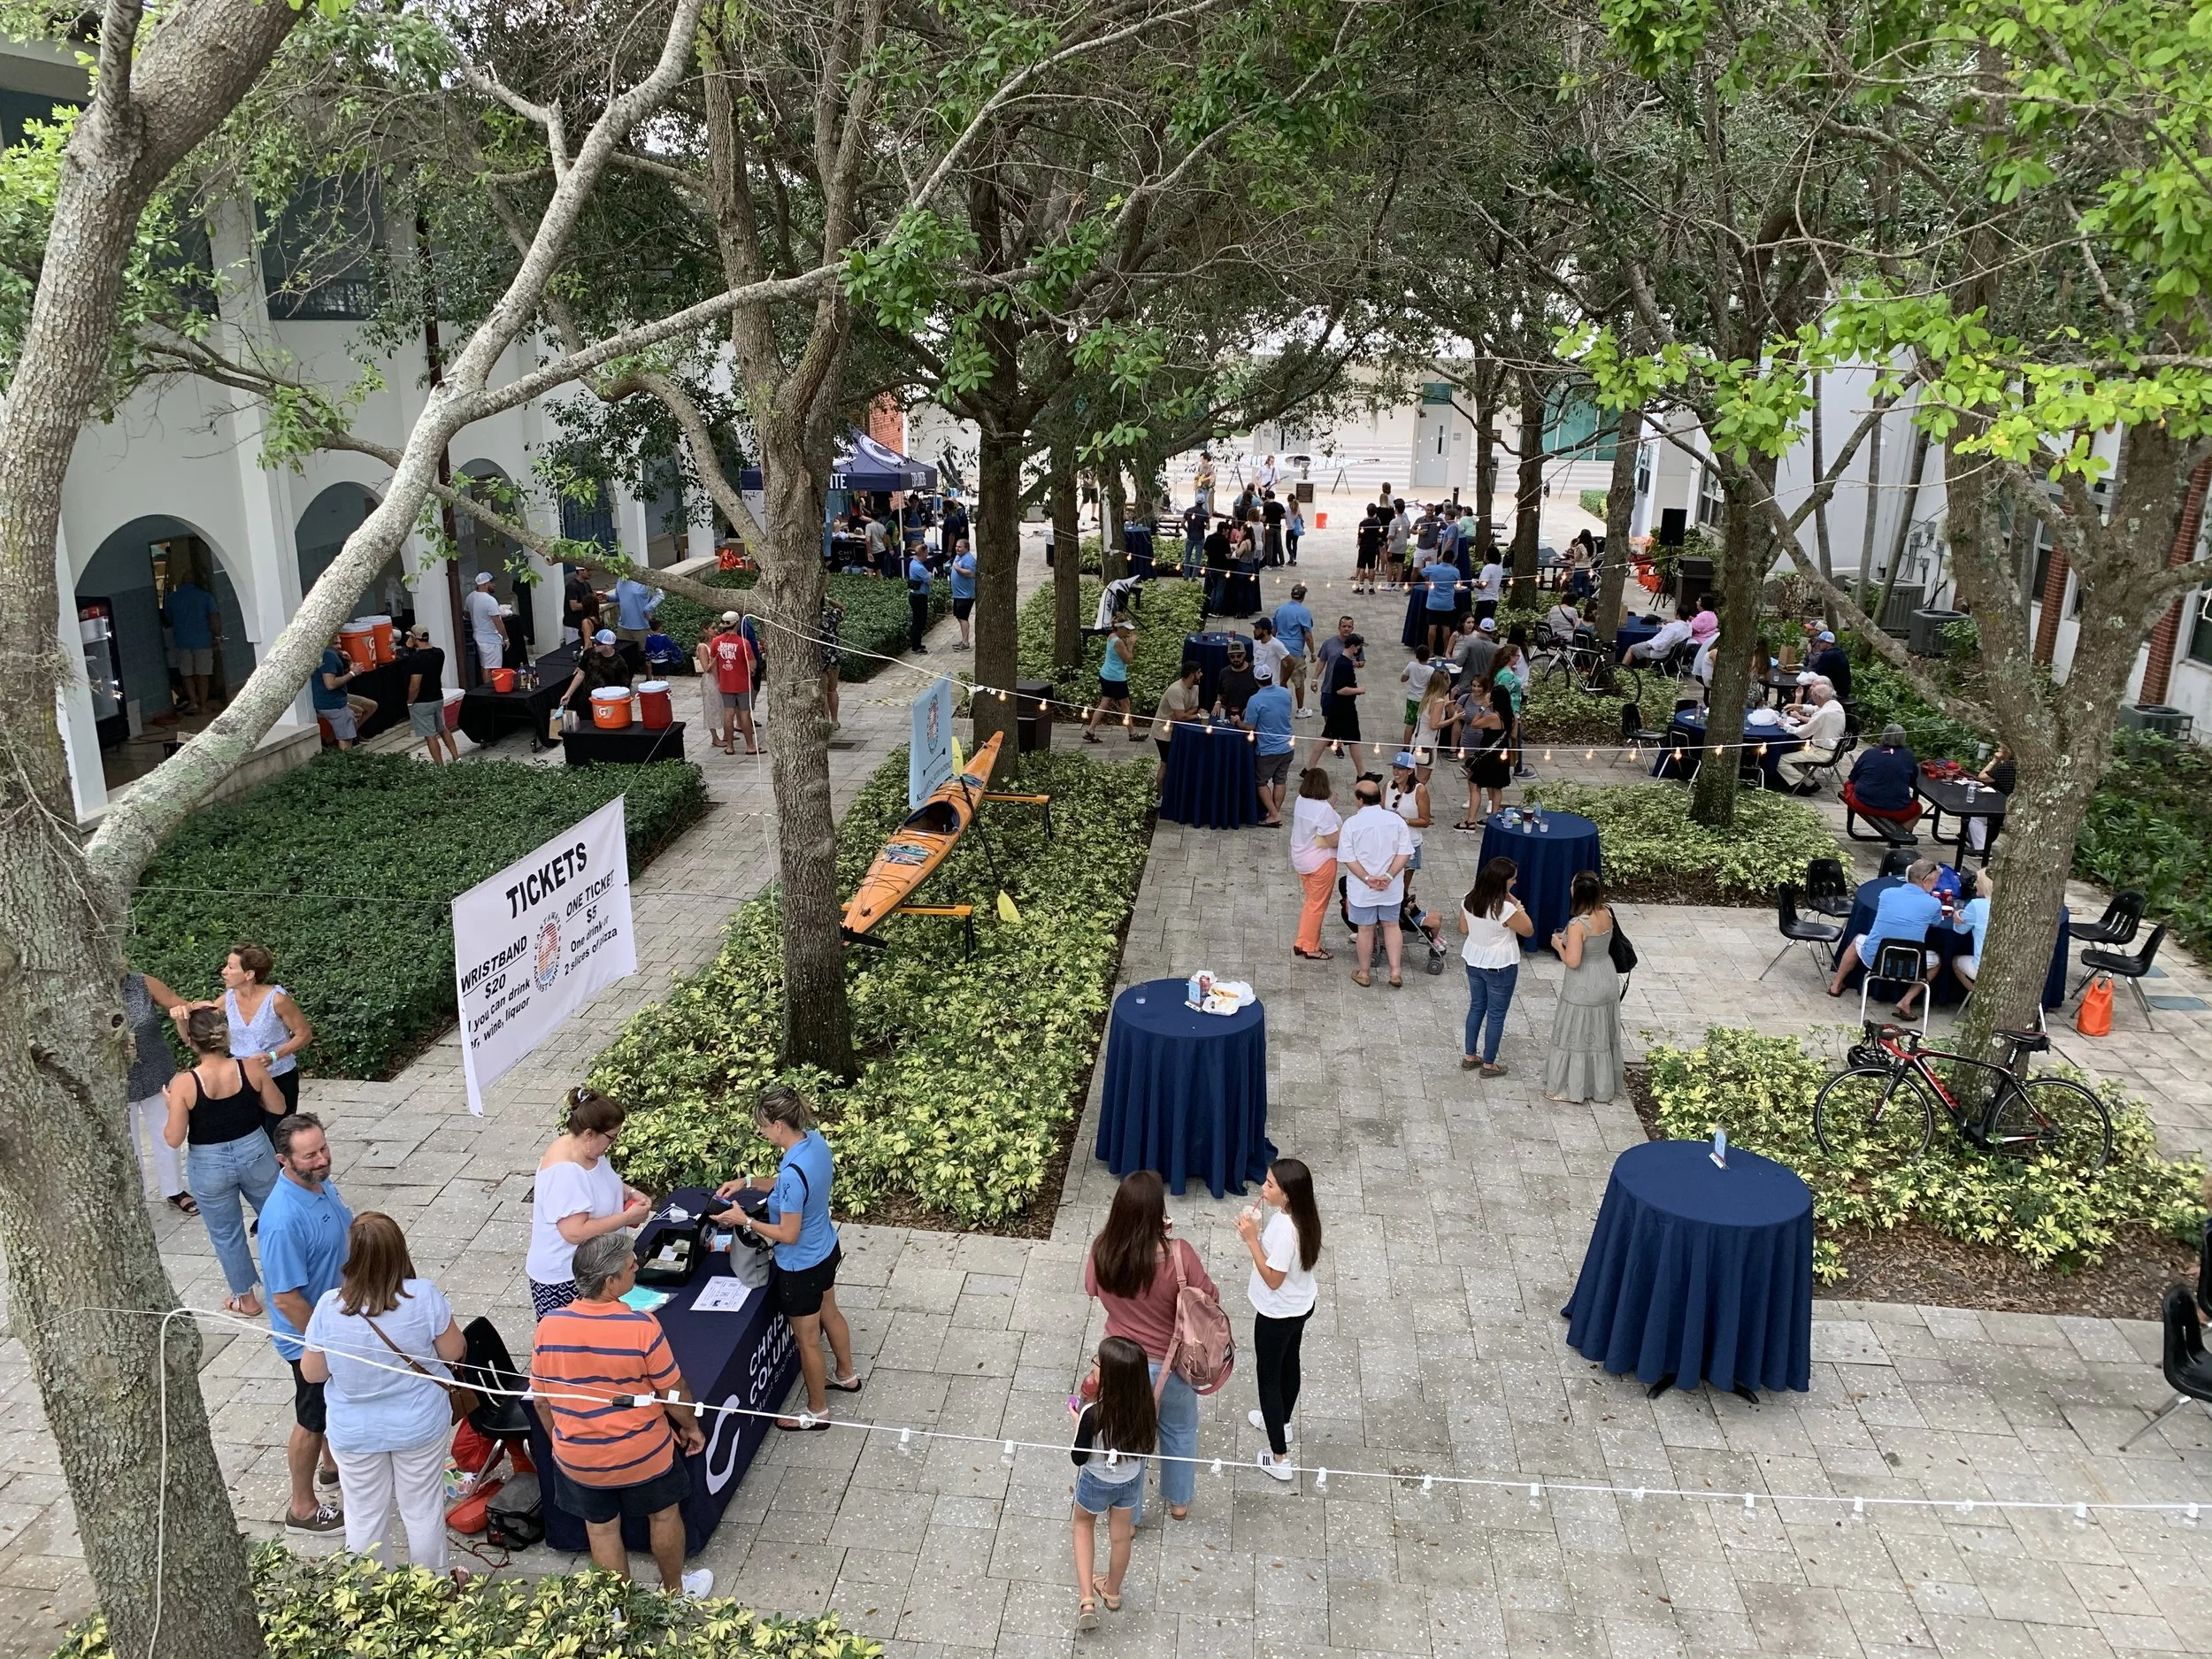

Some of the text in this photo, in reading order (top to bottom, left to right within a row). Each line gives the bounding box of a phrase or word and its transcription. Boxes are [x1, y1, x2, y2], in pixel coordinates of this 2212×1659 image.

[598, 707, 609, 717] G
[505, 841, 588, 919] TICKETS
[566, 869, 615, 917] ONE TICKET
[571, 936, 585, 953] One
[586, 921, 603, 942] drink
[587, 904, 598, 924] $5
[460, 935, 527, 994] WRISTBAND
[565, 963, 570, 977] 2
[570, 948, 590, 972] slices
[599, 927, 618, 950] pizza
[473, 1010, 489, 1033] you
[490, 996, 506, 1016] can
[508, 978, 531, 1002] drink
[485, 972, 507, 1000] $20
[483, 1018, 504, 1042] wine,
[505, 995, 531, 1022] liquor
[749, 1311, 785, 1377] CHRIS
[749, 1323, 795, 1405] COLUM
